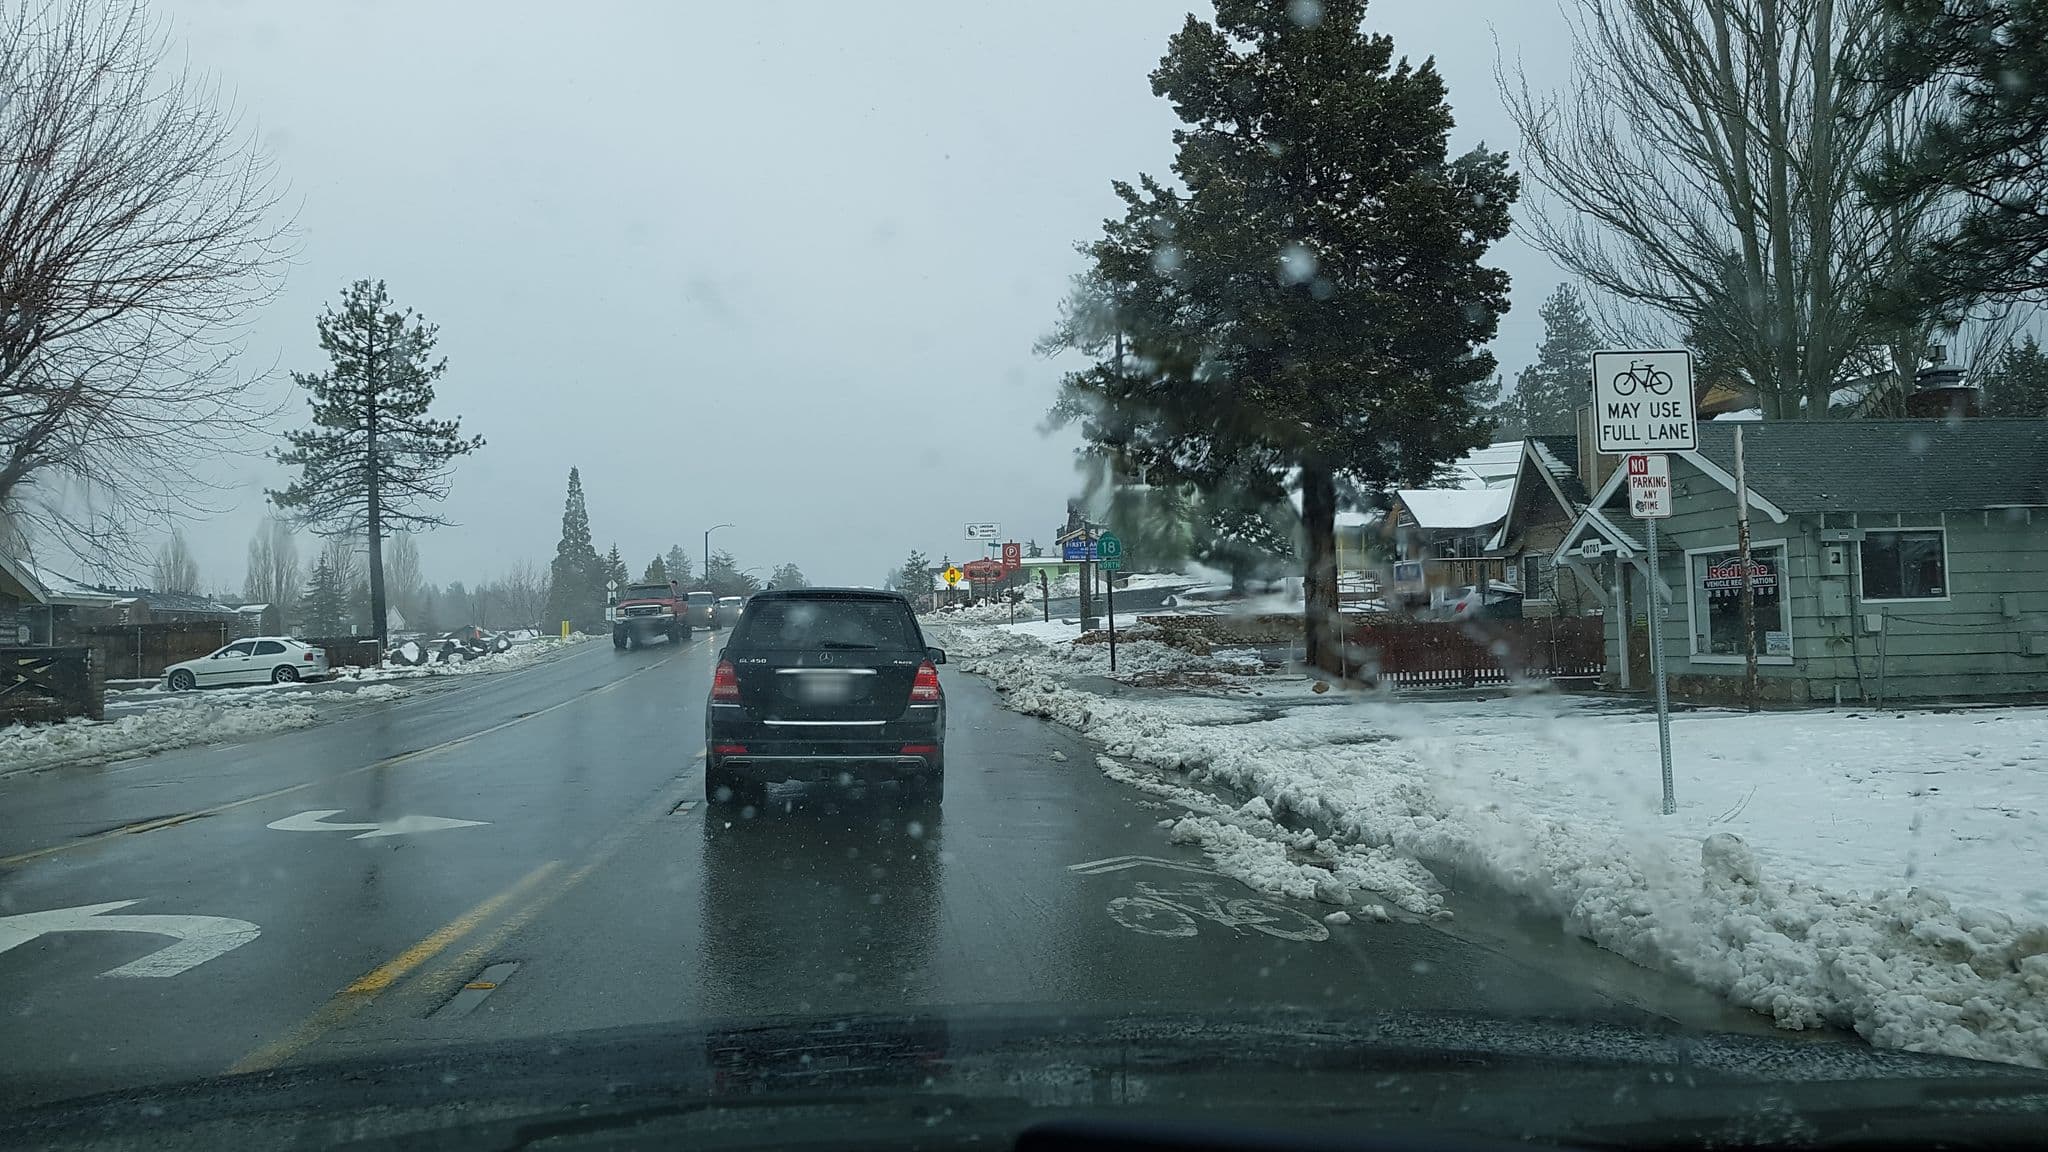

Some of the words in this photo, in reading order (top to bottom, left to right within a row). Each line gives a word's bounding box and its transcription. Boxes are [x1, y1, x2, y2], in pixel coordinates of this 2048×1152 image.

[1608, 402, 1641, 419] MAY
[1649, 401, 1682, 418] USE
[1603, 424, 1641, 441] FULL
[1648, 423, 1690, 440] LANE
[1631, 459, 1645, 472] NO
[1632, 476, 1667, 488] PARKING
[1643, 490, 1658, 499] ANY
[1644, 501, 1659, 510] TIME
[1102, 541, 1116, 554] 18
[1098, 561, 1121, 569] NORTH
[1706, 580, 1729, 588] VEHICLE
[1706, 587, 1774, 598] SERVES
